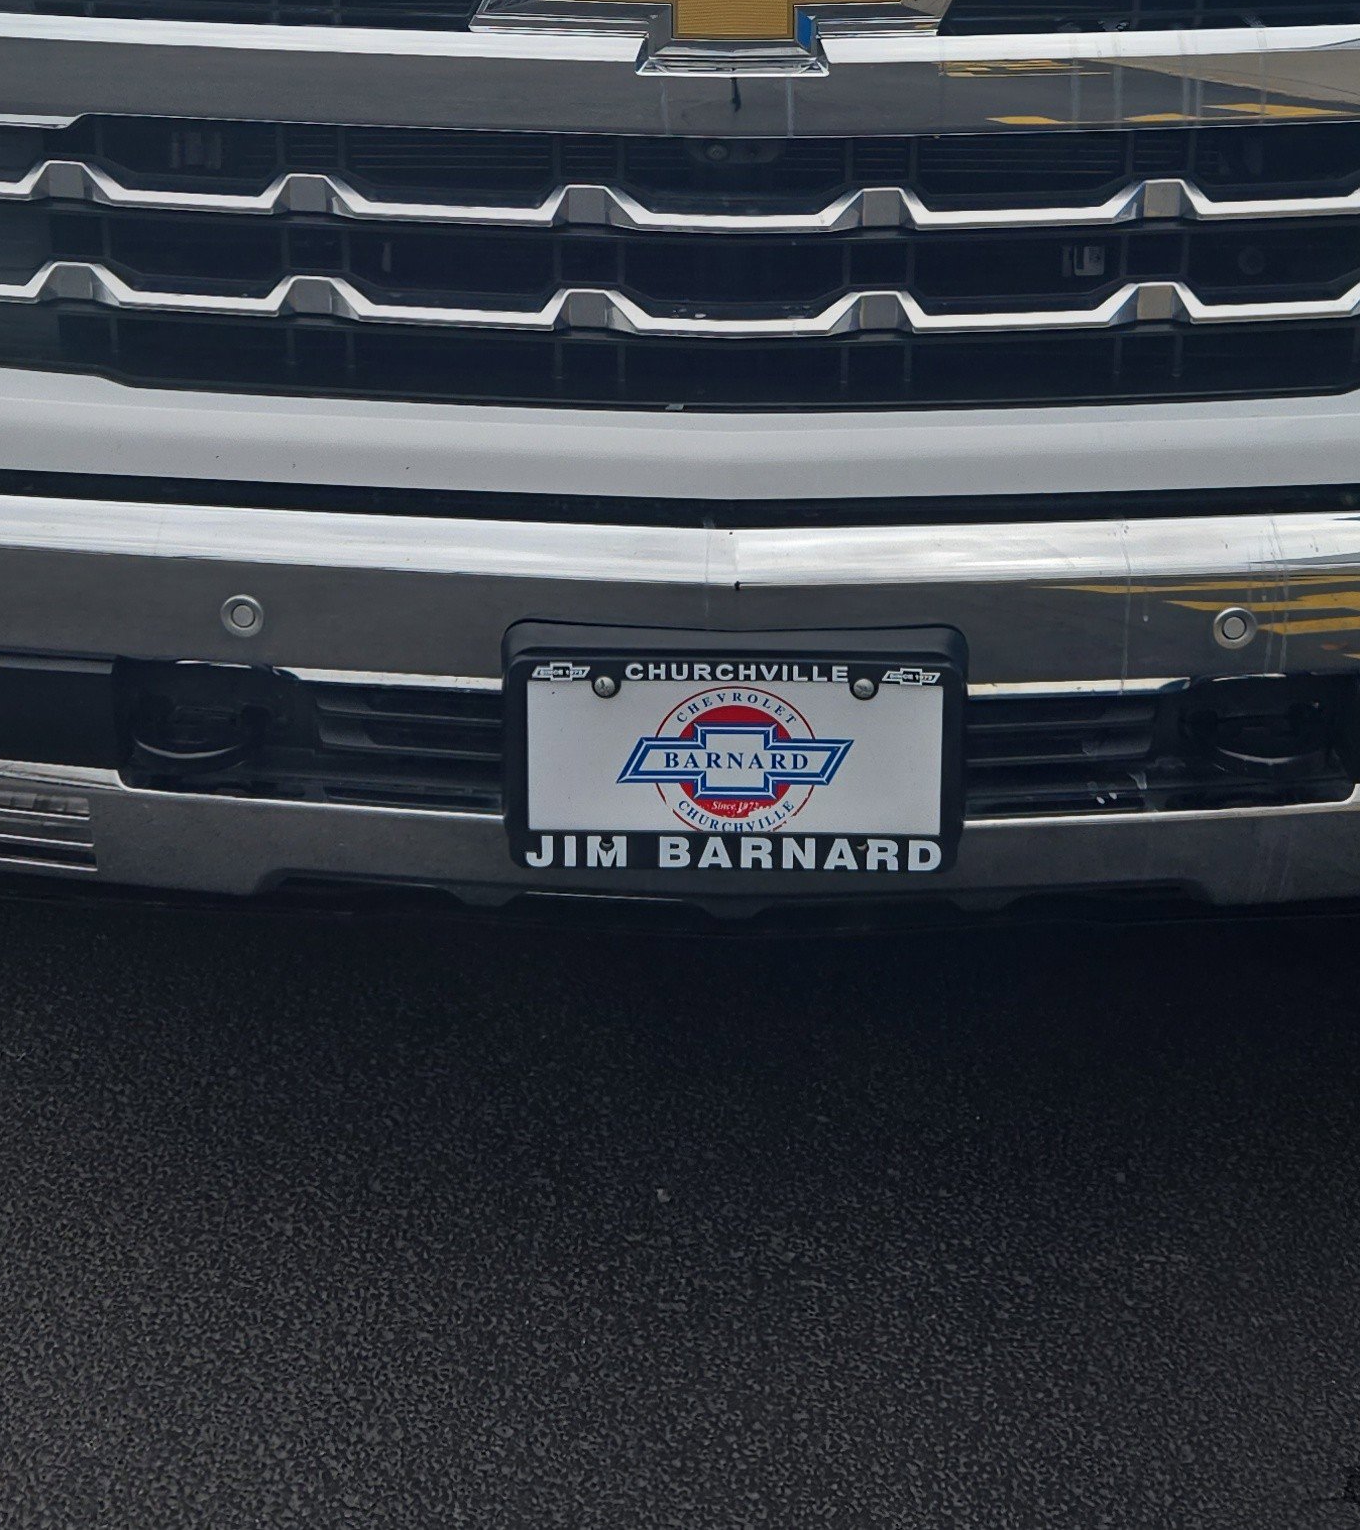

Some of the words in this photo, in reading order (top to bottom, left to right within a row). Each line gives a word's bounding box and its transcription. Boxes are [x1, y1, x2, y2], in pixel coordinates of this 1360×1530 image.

[624, 663, 849, 683] CHURCHVILLE
[676, 692, 797, 724] CHEVROLET
[664, 751, 809, 769] BARNARD
[678, 800, 795, 831] CHURCHVILLE
[525, 835, 628, 869] JIM
[659, 836, 942, 871] BARNARD
